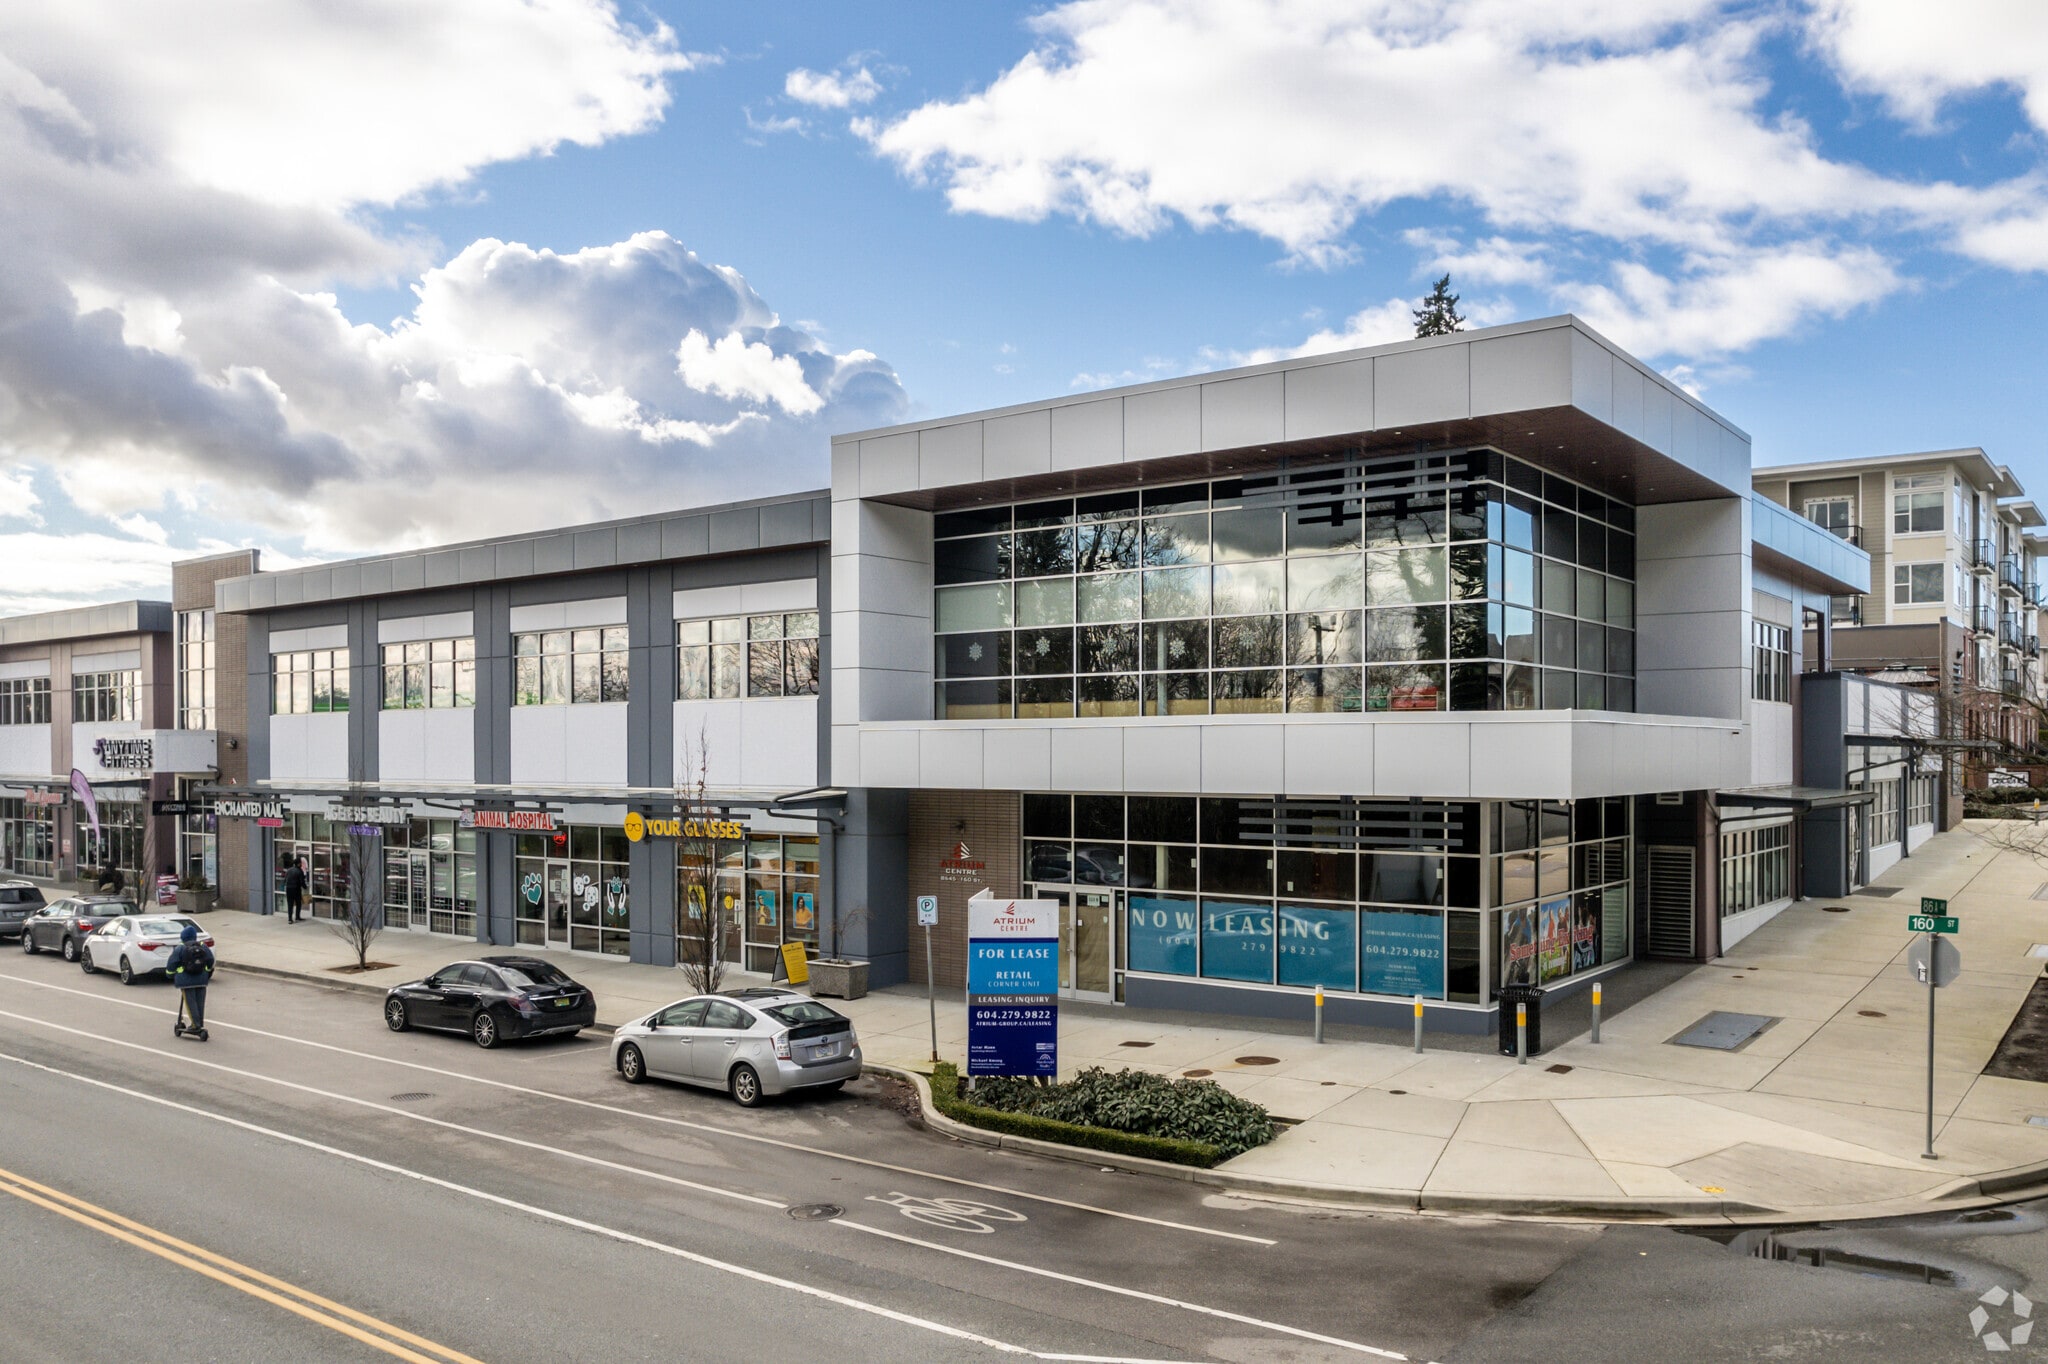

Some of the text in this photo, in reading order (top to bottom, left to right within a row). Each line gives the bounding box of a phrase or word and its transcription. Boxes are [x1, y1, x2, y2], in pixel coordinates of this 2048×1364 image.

[104, 739, 151, 754] ANYTIME
[104, 755, 151, 768] FITNESS
[214, 801, 284, 818] ENCHANTED NAIL
[474, 811, 553, 830] ANIMAL HOSPITAL
[645, 819, 743, 839] YOUR GLASSES
[940, 860, 985, 869] ATRIUM
[993, 917, 1035, 925] ATRIUM
[1132, 908, 1329, 940] NOW LEASING
[1912, 917, 1955, 930] 160 ST
[979, 949, 1050, 959] FOR LEASE
[1366, 945, 1439, 958] 604.279.9822
[996, 971, 1032, 979] RETAIL
[1015, 996, 1050, 1004] INQUIRY
[976, 1010, 1051, 1019] 604.279.9822
